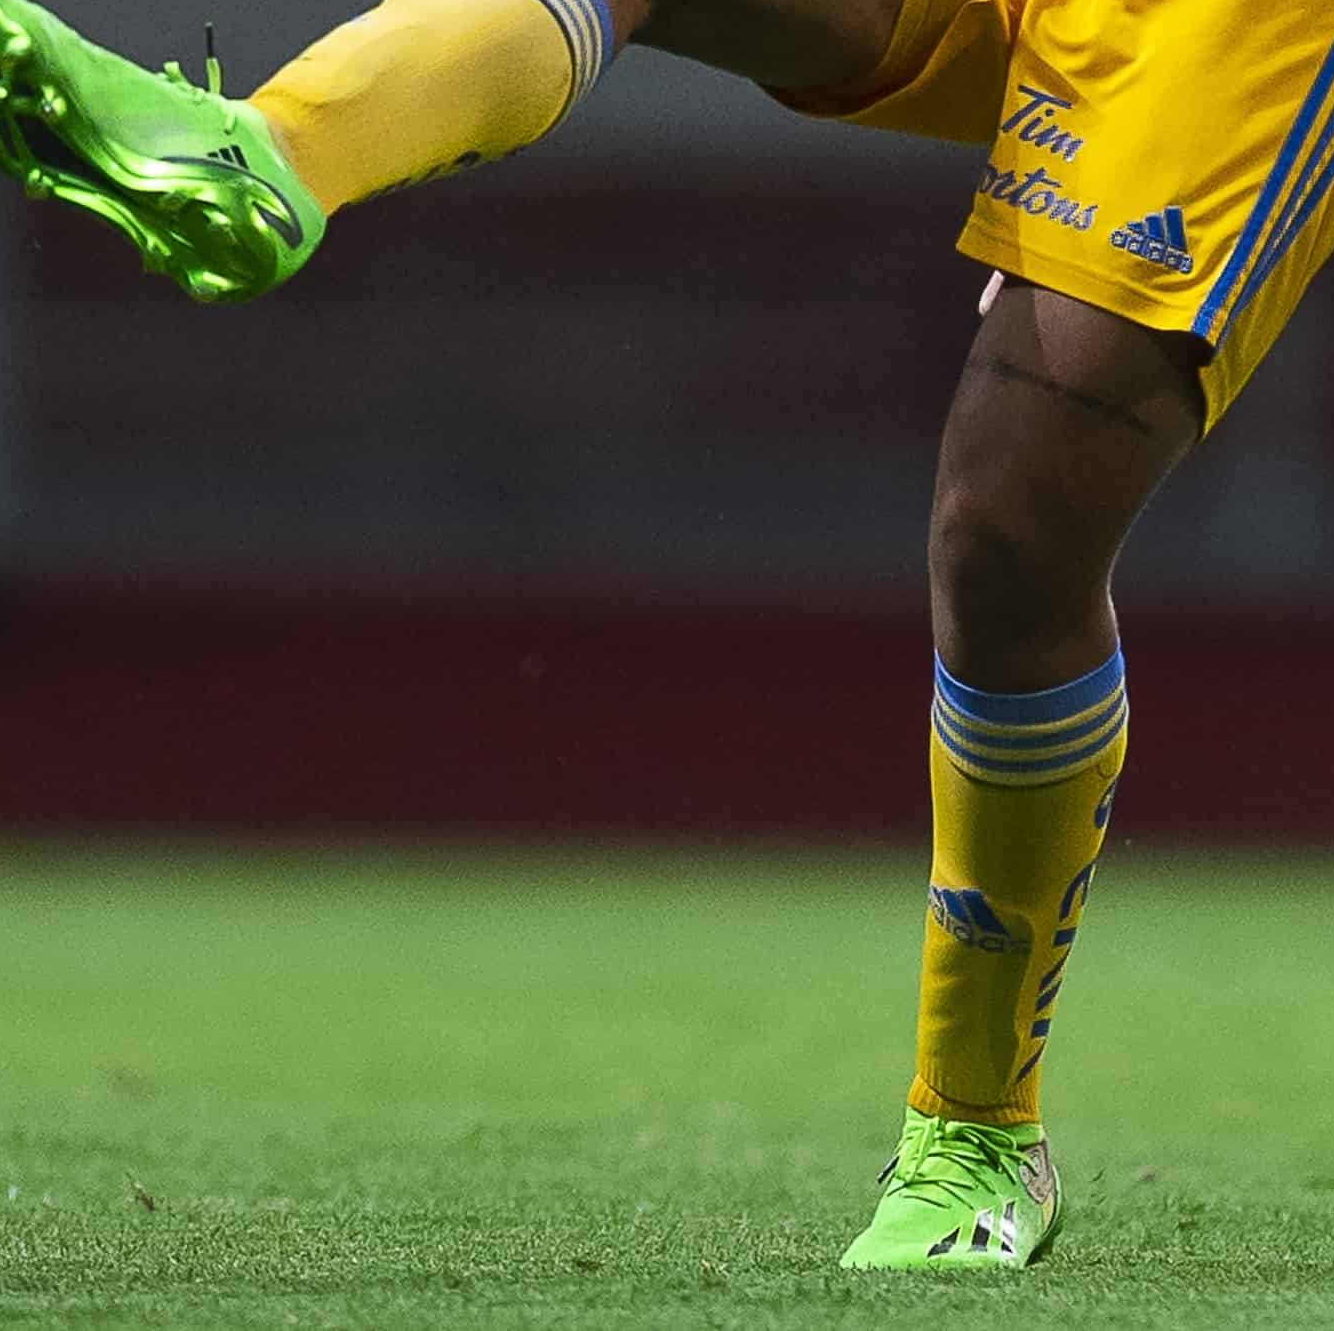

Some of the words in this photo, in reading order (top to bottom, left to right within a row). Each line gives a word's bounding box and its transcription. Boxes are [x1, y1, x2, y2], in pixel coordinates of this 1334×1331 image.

[1001, 84, 1084, 162] Tim
[978, 163, 1099, 231] ortons
[1110, 226, 1195, 275] adidas
